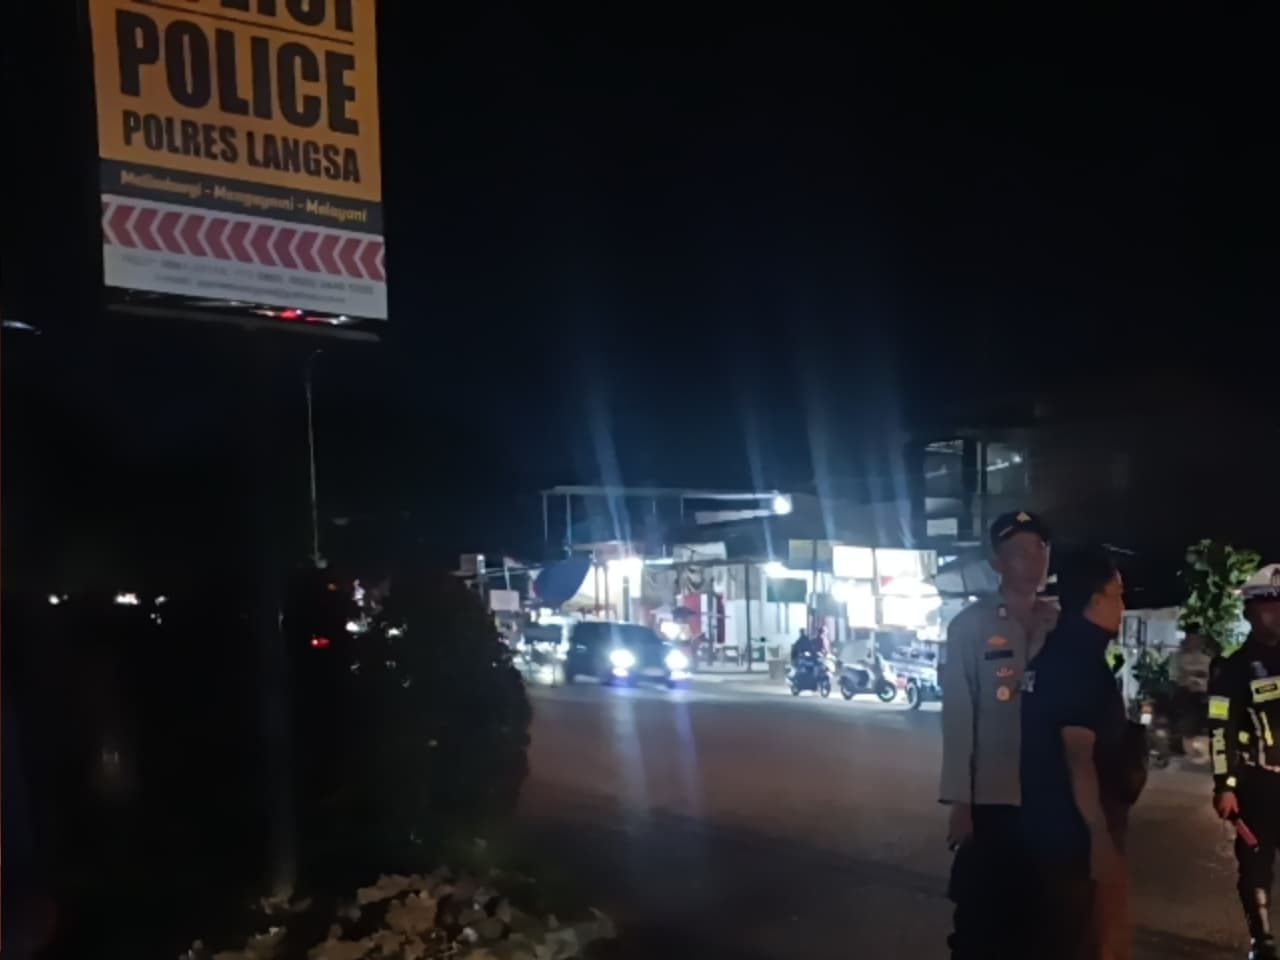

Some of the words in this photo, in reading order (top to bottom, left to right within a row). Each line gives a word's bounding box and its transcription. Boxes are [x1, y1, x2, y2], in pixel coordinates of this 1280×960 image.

[115, 8, 359, 136] POLICE
[122, 109, 239, 164] POLRES
[246, 131, 361, 184] LANGSA
